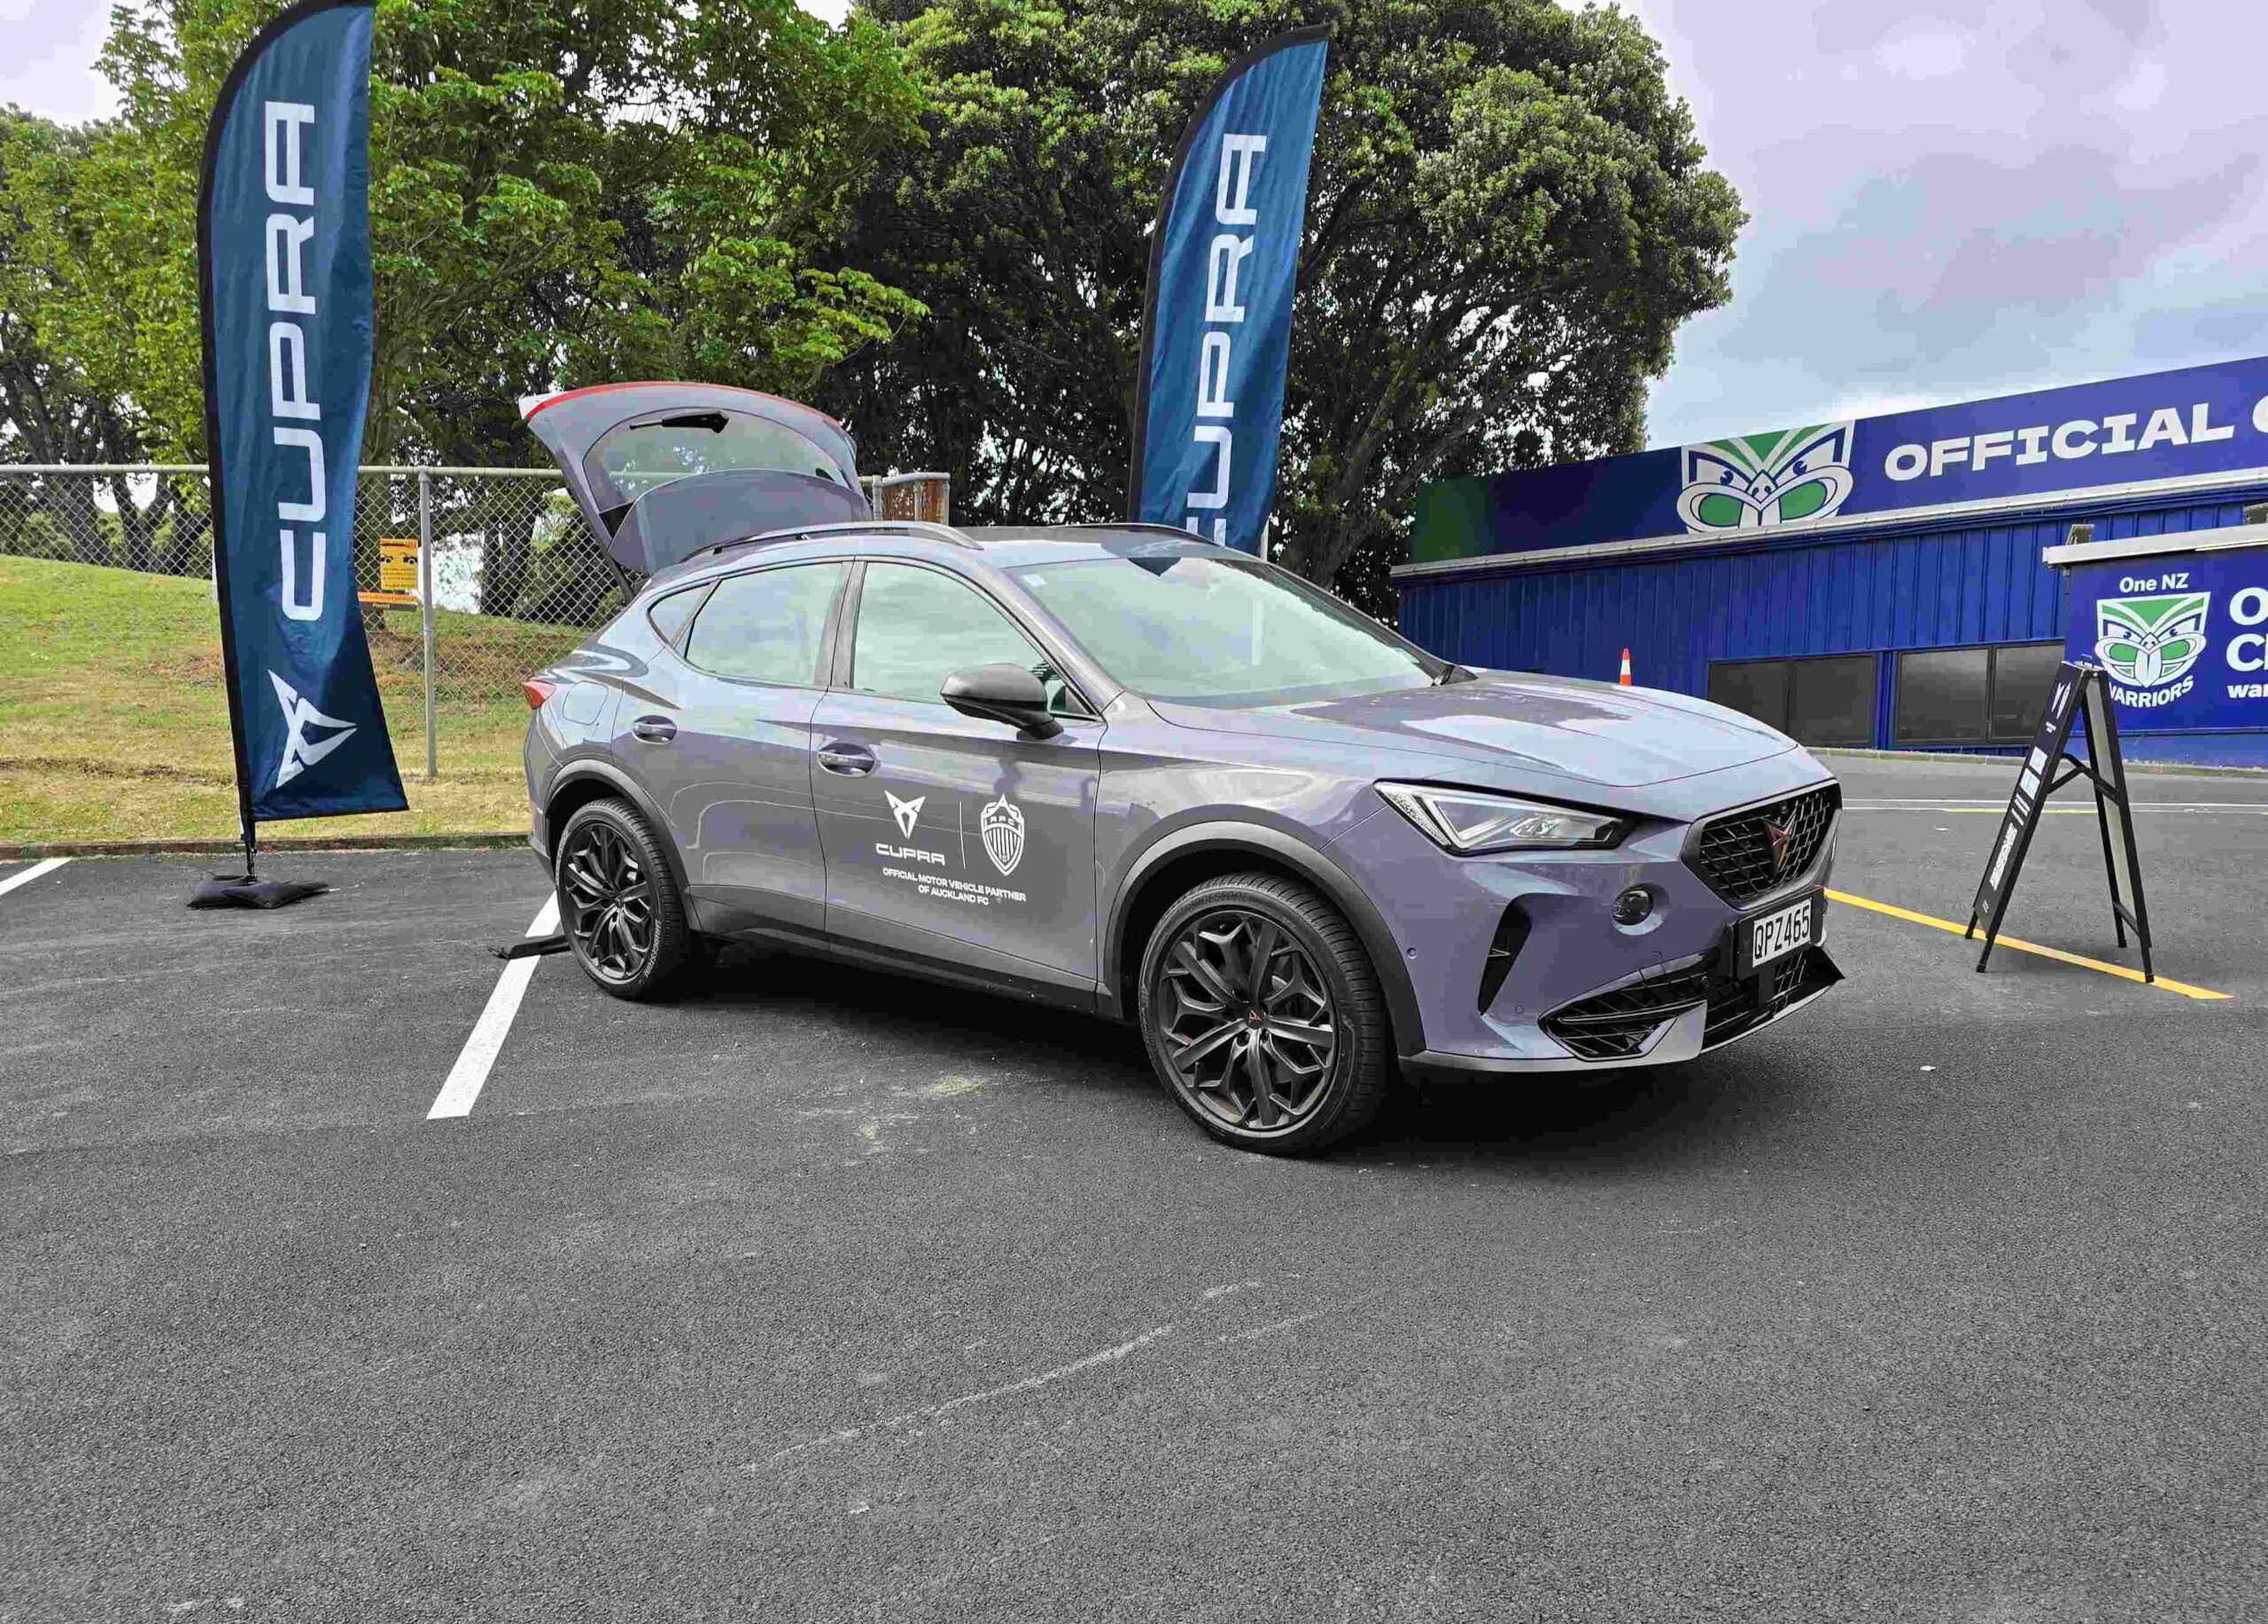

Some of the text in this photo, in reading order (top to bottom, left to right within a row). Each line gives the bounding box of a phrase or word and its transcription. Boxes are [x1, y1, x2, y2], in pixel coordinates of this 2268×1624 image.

[264, 101, 327, 621] CUPRA
[1884, 403, 2234, 481] OFFICIAL
[2119, 572, 2189, 593] One NZ
[875, 843, 945, 866] CUPRA
[882, 866, 1027, 902] OFFICIAL MOTOR VEHICLE PARTNER
[918, 884, 990, 905] OF AUCKLAND FC
[1754, 904, 1810, 960] QPZ465
